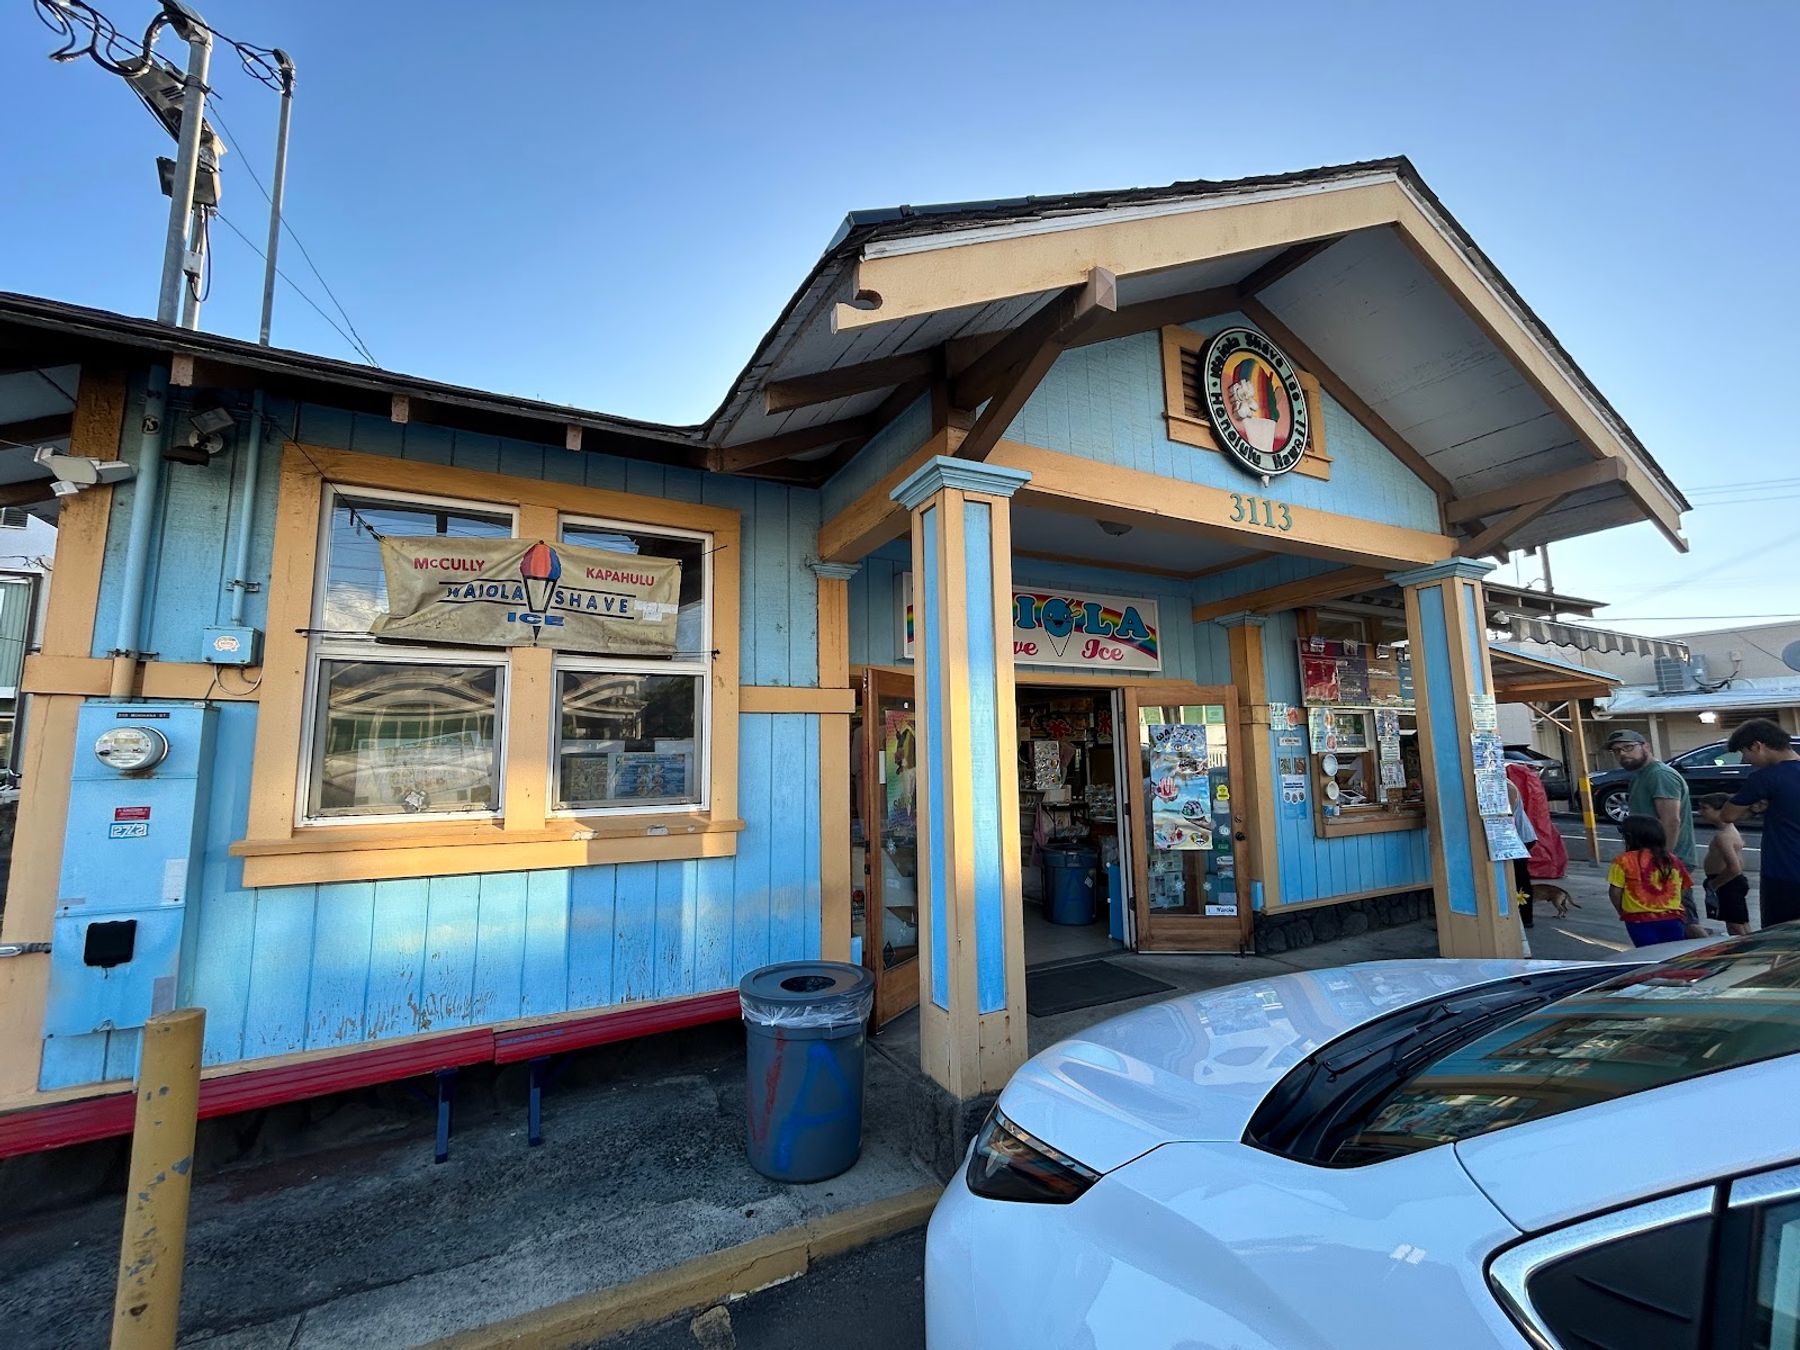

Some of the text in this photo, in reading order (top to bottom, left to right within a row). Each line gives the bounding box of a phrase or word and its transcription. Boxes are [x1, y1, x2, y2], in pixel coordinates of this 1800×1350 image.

[1210, 333, 1301, 401] Waiola Shave Ice
[1211, 392, 1261, 465] Honolulu
[1230, 493, 1292, 531] 3113
[586, 567, 655, 586] KAPAHULU
[555, 590, 628, 613] SHAVE
[508, 612, 564, 626] ICE
[1013, 595, 1151, 639] IOLA
[1081, 639, 1124, 661] Ice
